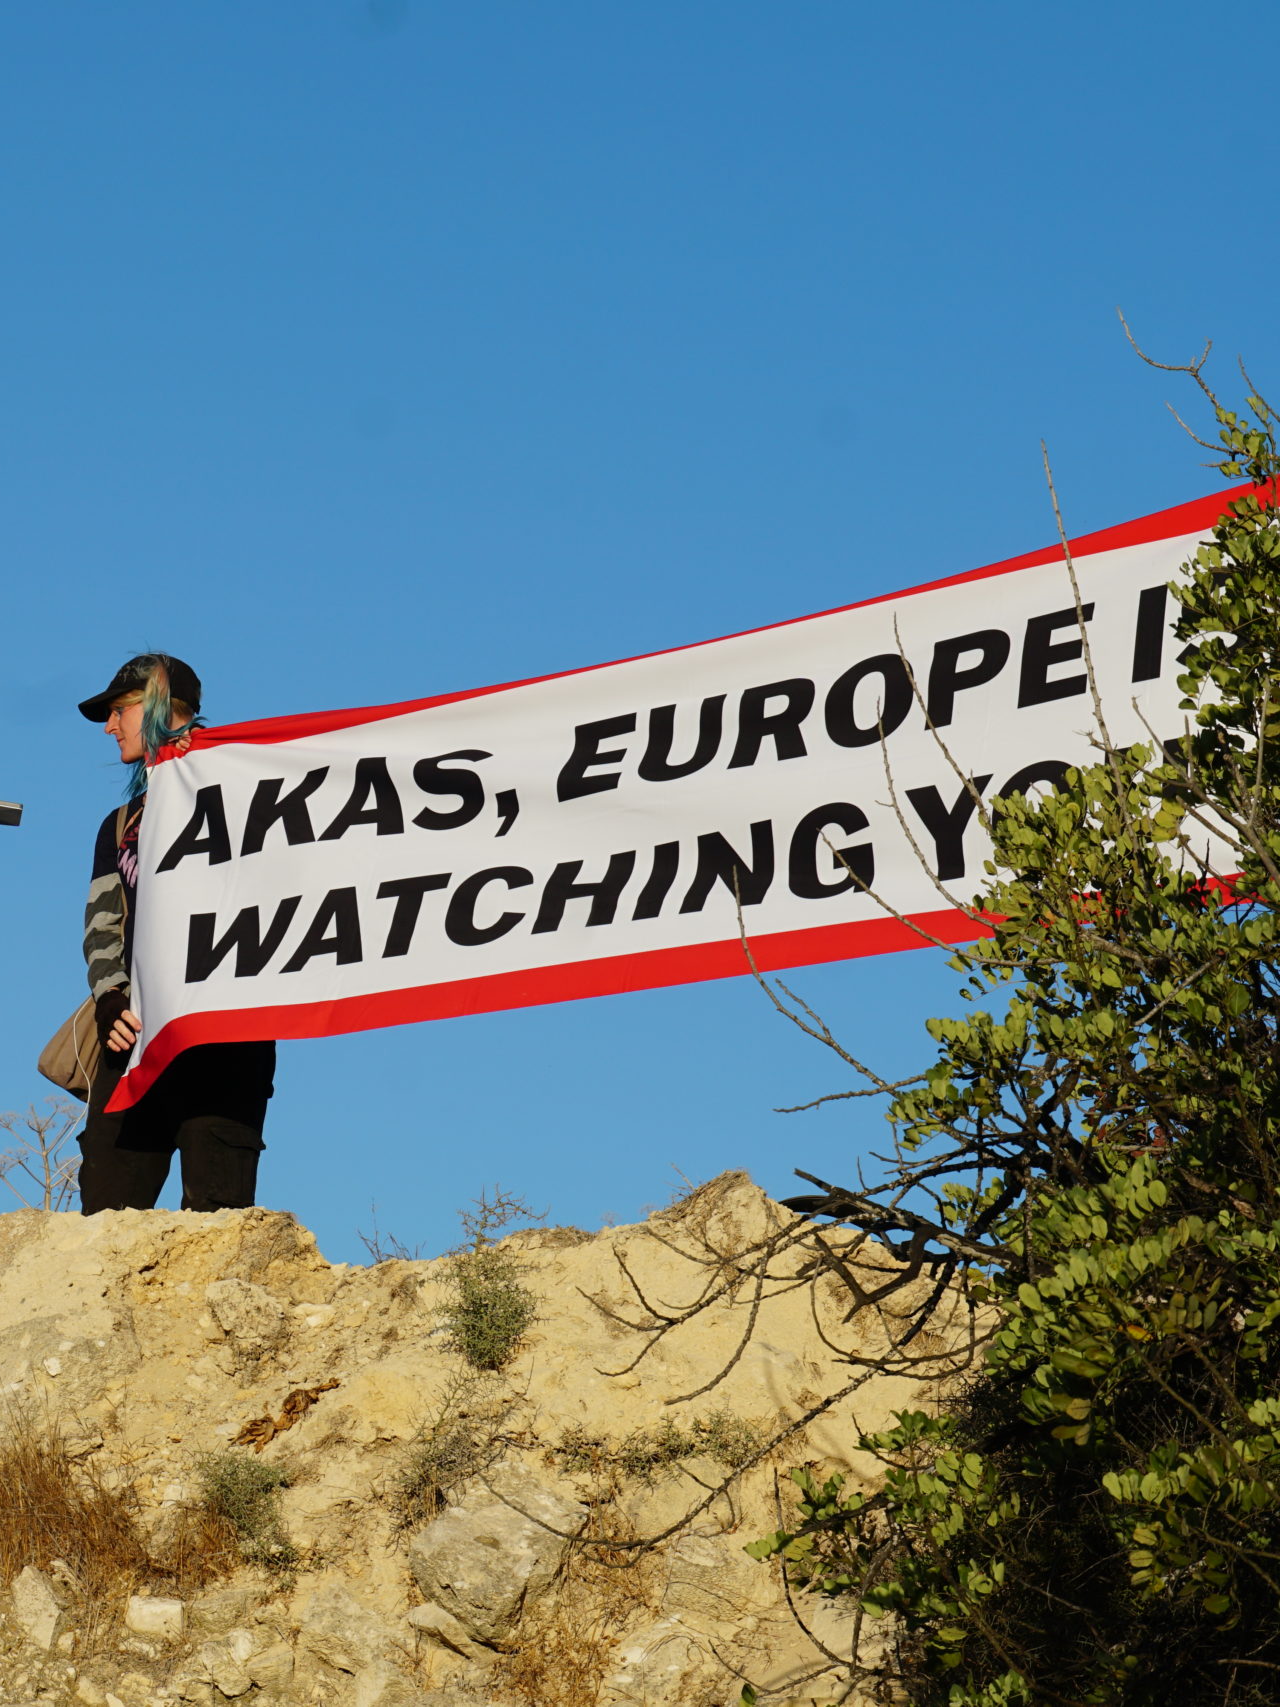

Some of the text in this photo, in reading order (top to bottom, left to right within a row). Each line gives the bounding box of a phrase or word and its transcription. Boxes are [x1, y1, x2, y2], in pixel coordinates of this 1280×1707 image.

[156, 749, 520, 874] AKAS,
[556, 601, 1096, 803] EUROPE
[184, 802, 875, 984] WATCHING
